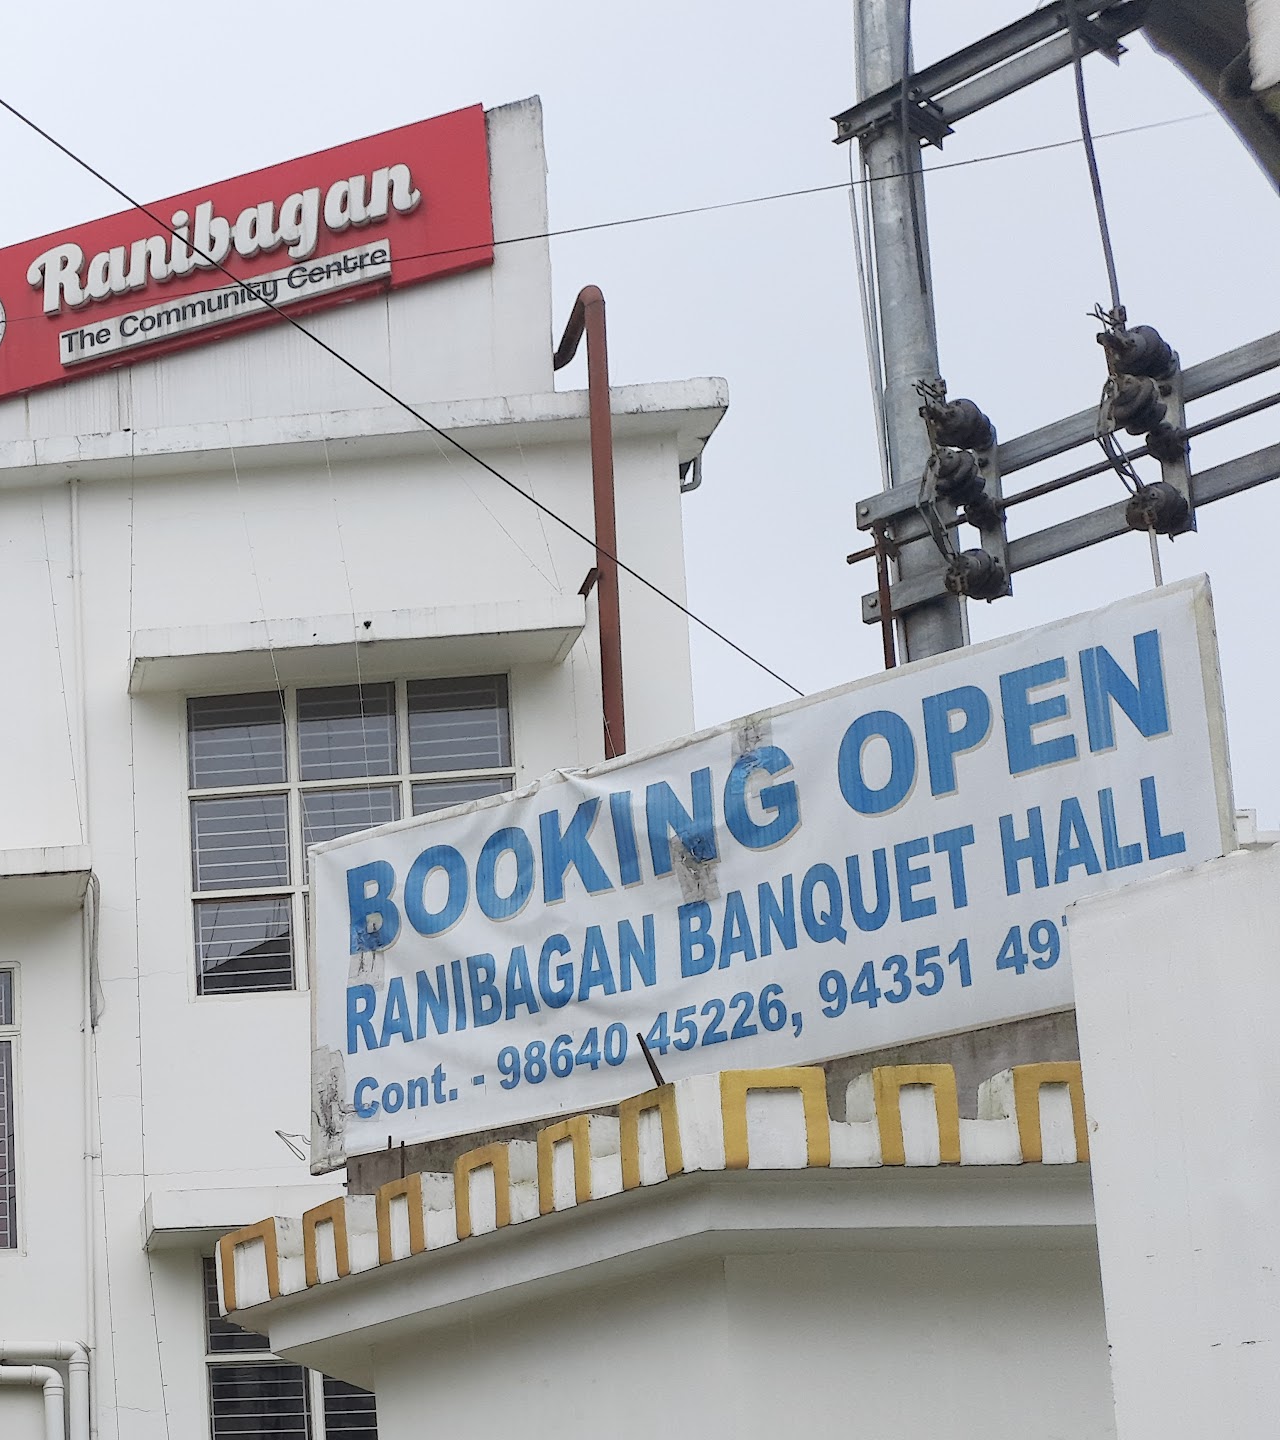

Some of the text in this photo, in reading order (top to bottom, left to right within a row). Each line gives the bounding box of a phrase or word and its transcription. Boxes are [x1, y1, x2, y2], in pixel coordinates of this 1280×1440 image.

[27, 162, 421, 316] Ranibagan
[60, 247, 388, 353] The Community Centre
[346, 628, 1171, 954] BOOKING OPEN
[346, 775, 1187, 1056] RANIBAGAN BANQUET HALL
[353, 1063, 458, 1119] Cont.
[496, 1022, 628, 1090] 98640
[642, 984, 803, 1056] 45226,
[818, 938, 972, 1019] 94351
[995, 914, 1067, 975] 49
